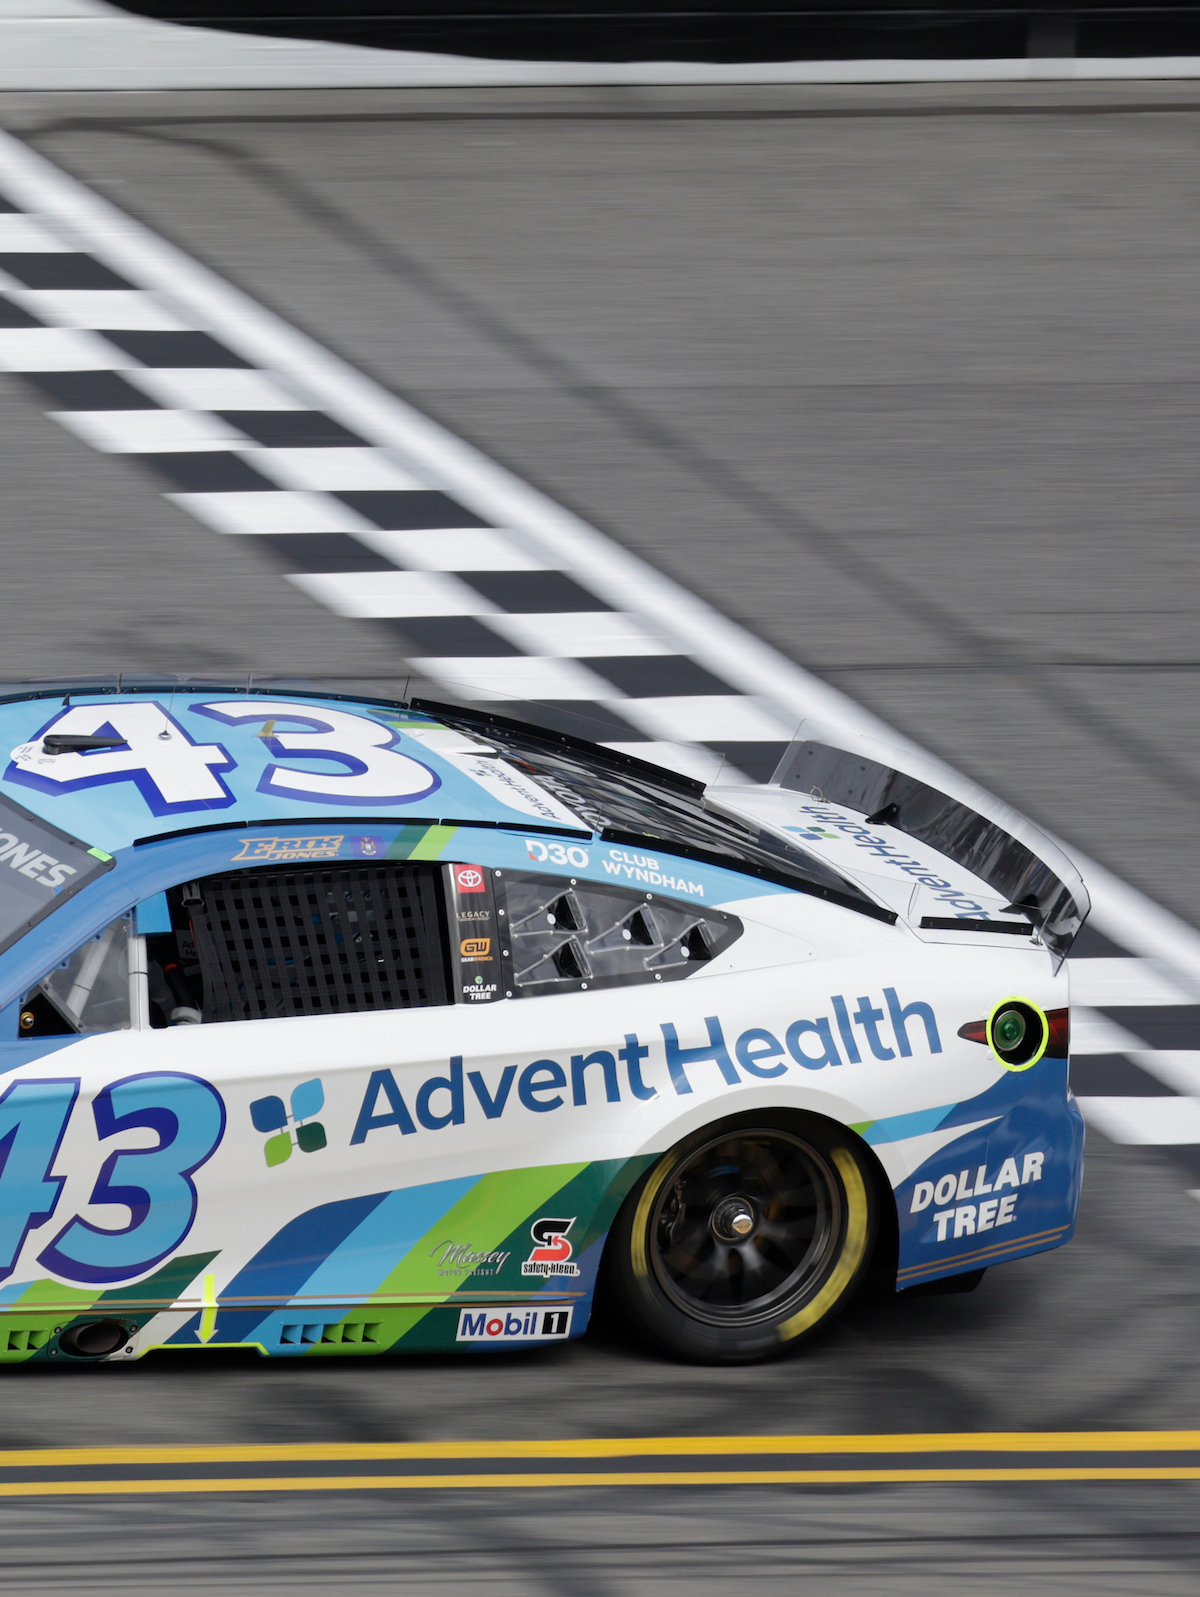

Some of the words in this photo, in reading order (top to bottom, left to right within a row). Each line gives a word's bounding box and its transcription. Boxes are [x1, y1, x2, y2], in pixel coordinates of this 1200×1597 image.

[2, 699, 442, 818] 43
[230, 835, 345, 861] ERIK
[268, 850, 341, 861] JONES
[609, 849, 660, 871] CLUB
[798, 805, 991, 921] AdventHealth
[601, 859, 705, 897] WYNDHAM
[456, 910, 490, 919] LEGACY
[463, 984, 497, 993] DOLLAR
[470, 992, 492, 1000] TREE
[910, 1151, 1045, 1214] DOLLAR
[933, 1193, 1018, 1242] TREE
[429, 1240, 511, 1275] Massey
[460, 1312, 538, 1336] Mobil
